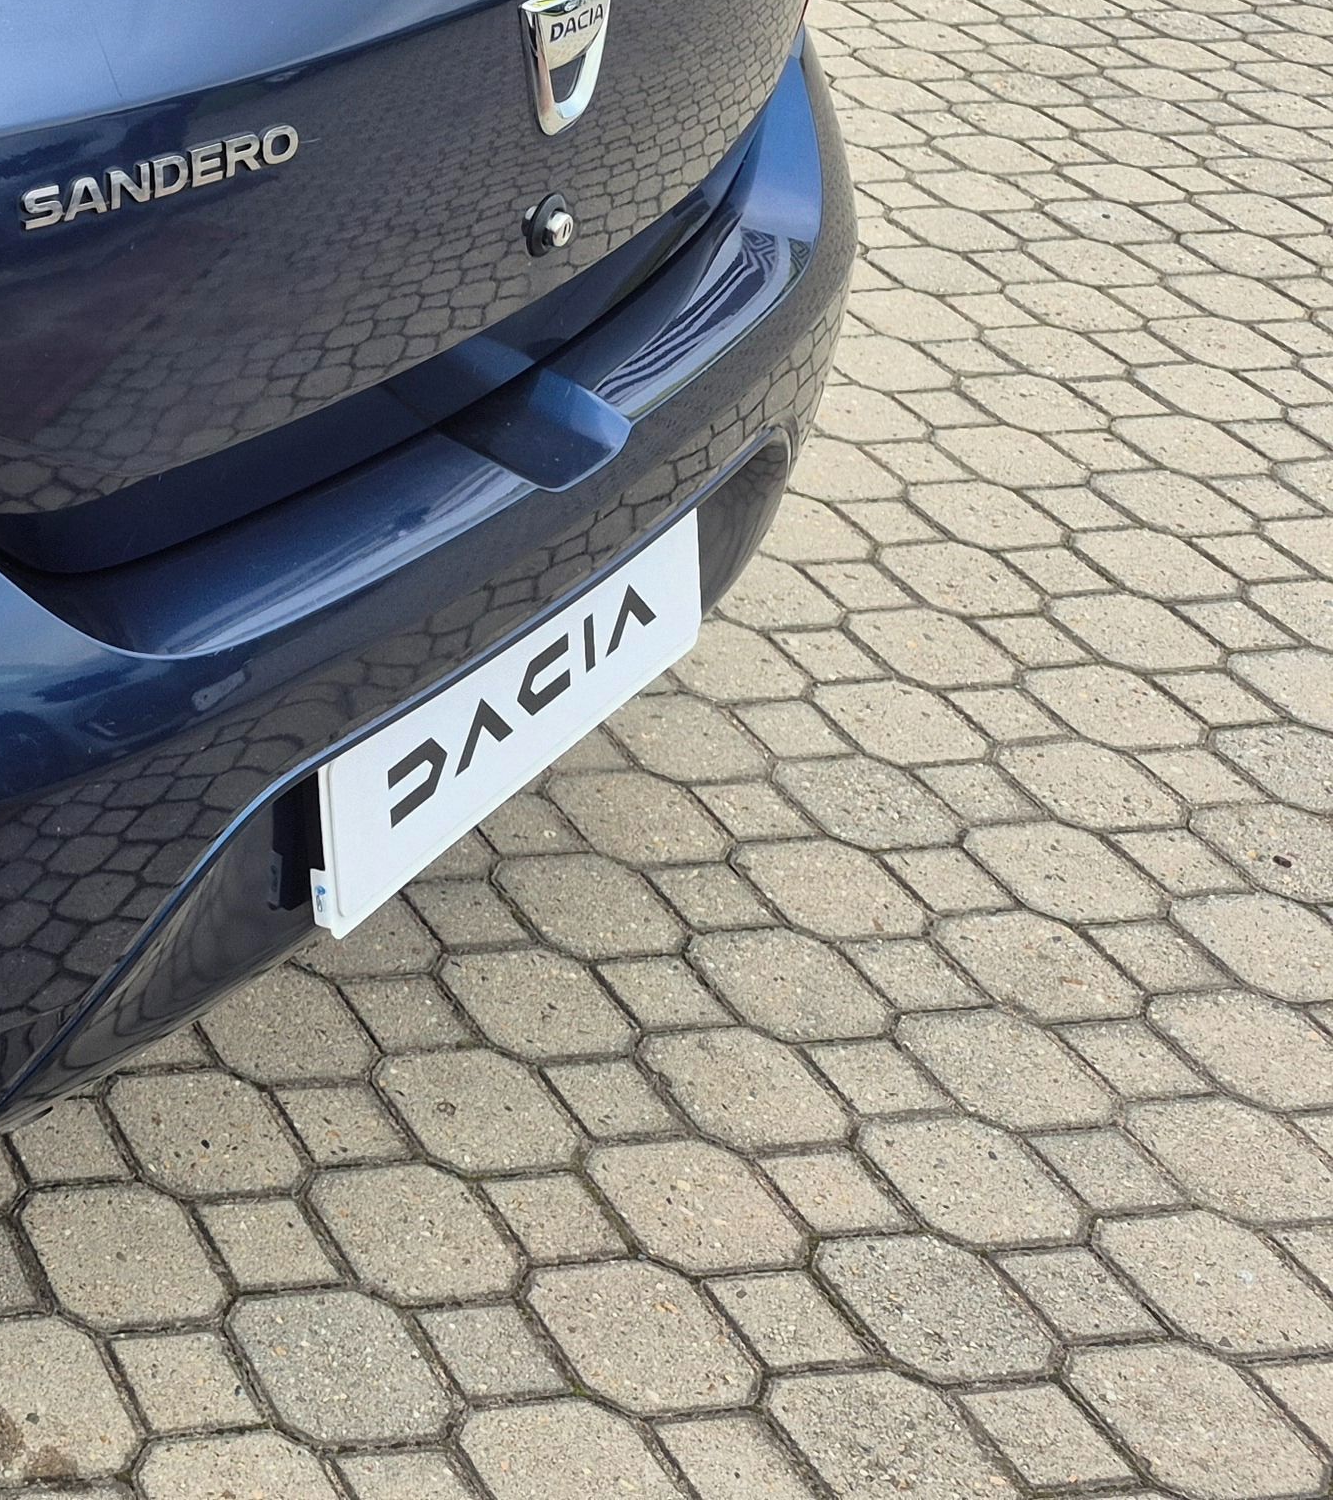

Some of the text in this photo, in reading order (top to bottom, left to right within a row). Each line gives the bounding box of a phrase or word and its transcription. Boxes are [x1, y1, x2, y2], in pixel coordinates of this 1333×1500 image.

[549, 3, 604, 43] DACIA
[21, 124, 300, 231] SANDERO
[387, 583, 657, 829] DACIA
